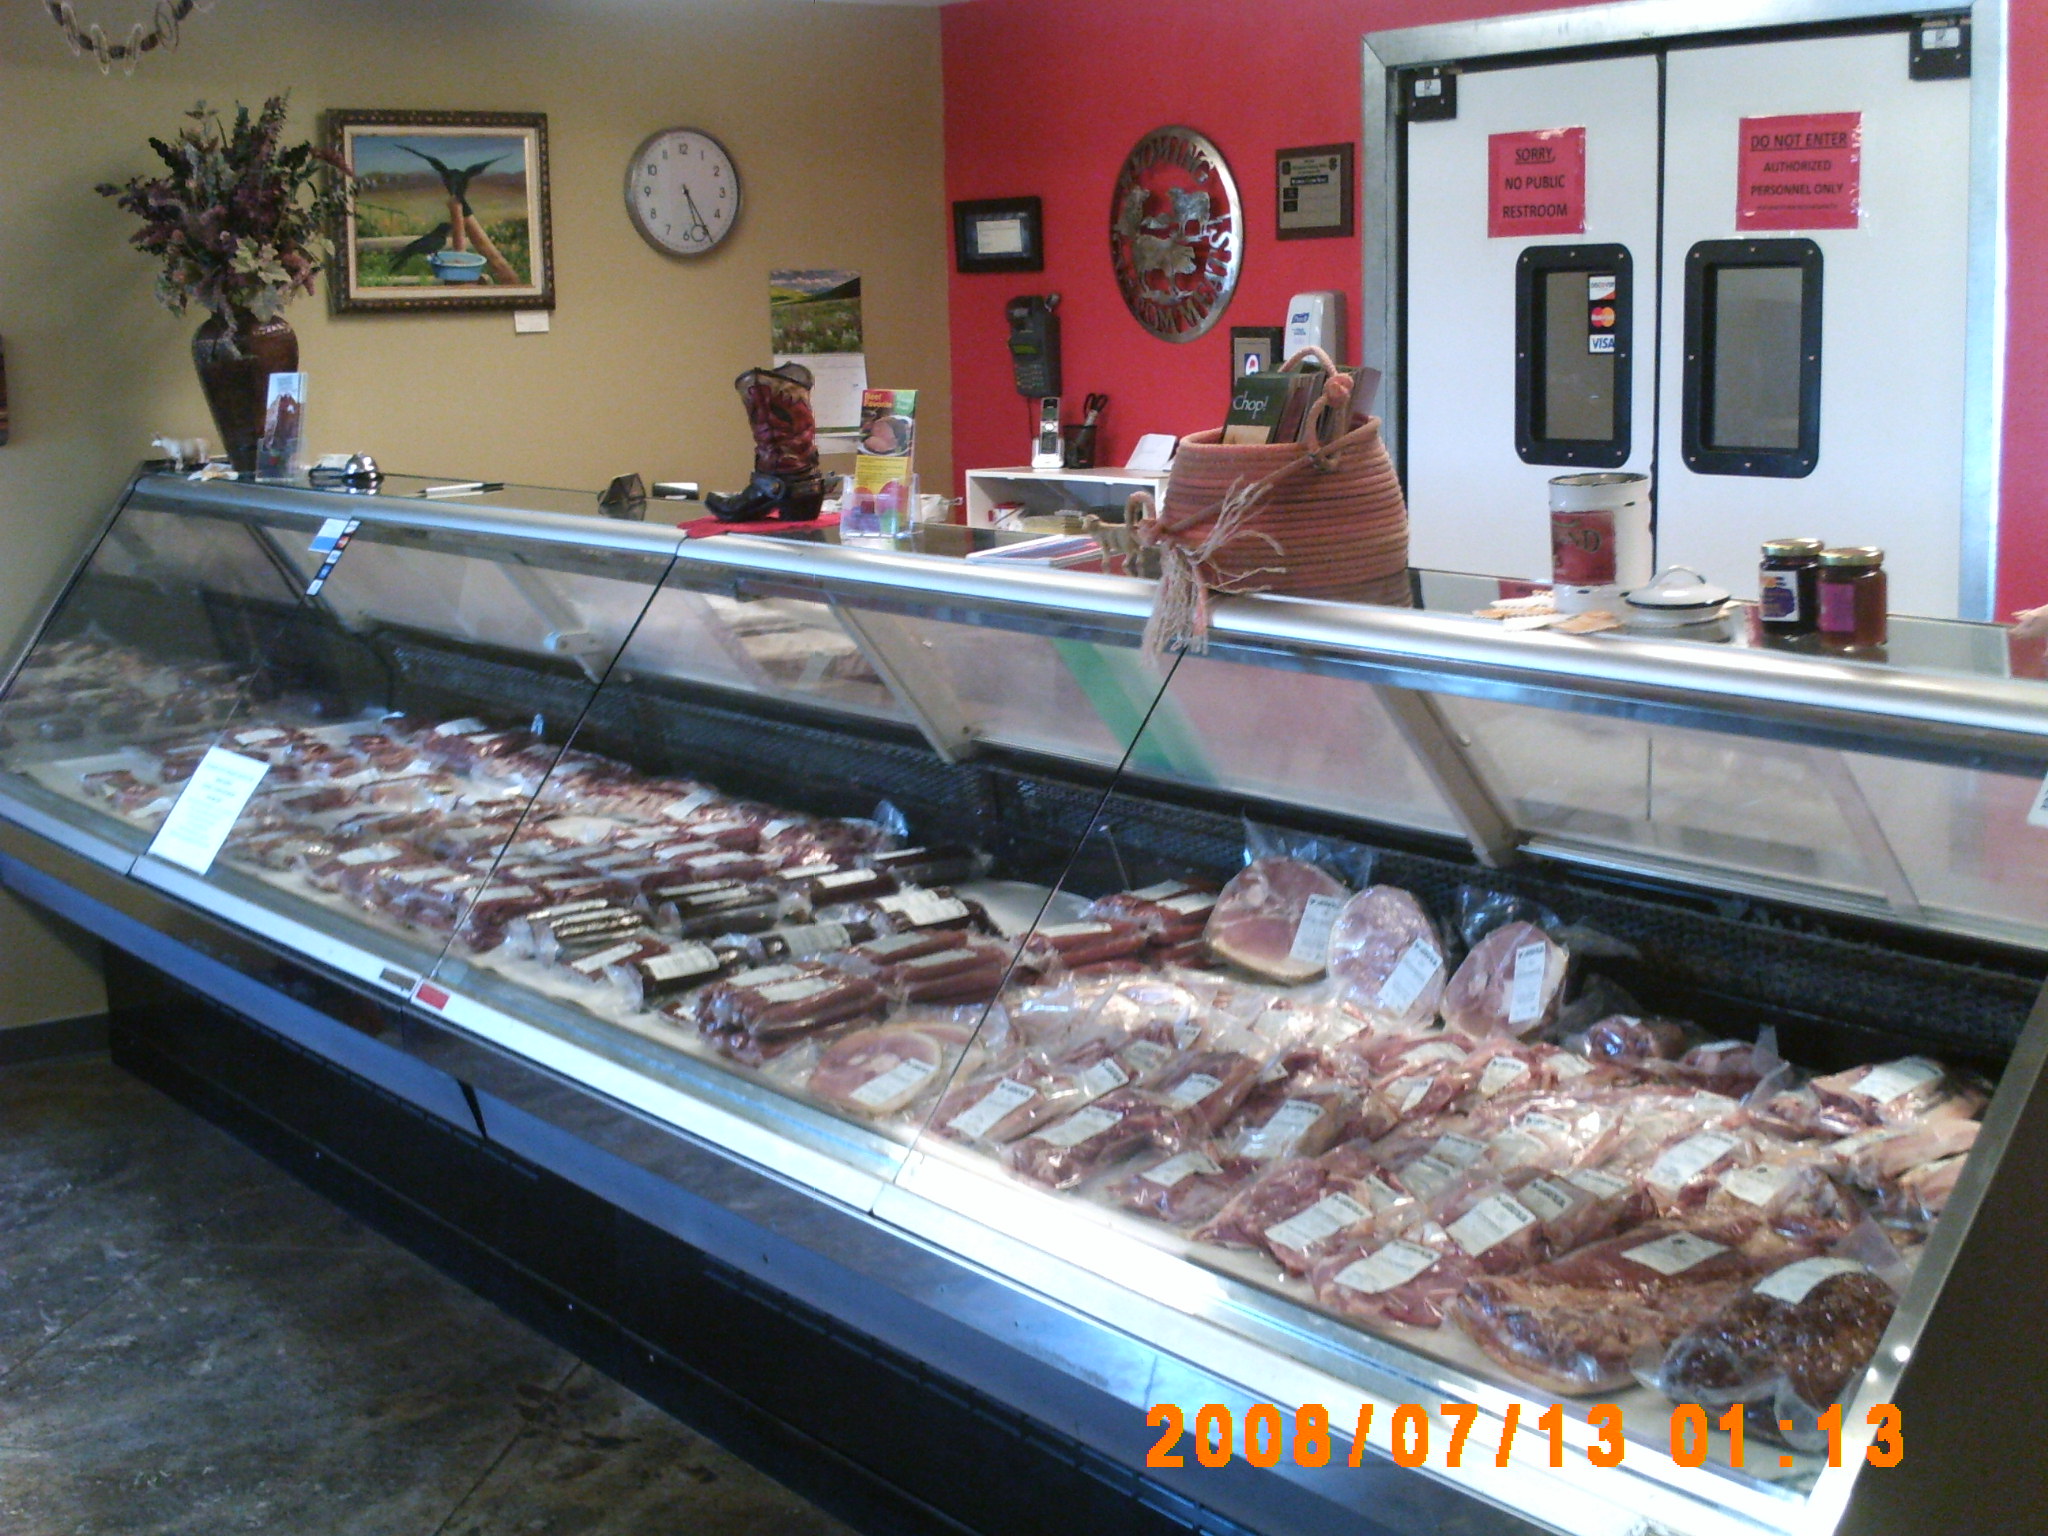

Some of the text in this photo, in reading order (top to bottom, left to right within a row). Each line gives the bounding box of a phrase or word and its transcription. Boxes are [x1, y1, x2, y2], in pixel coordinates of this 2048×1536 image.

[1751, 131, 1847, 149] DO NOT ENTER
[679, 143, 688, 155] 12
[647, 164, 657, 176] 10
[713, 165, 720, 177] 2
[1763, 160, 1831, 173] AUTHORIZED
[1505, 174, 1566, 190] NO PUBLIC
[644, 186, 651, 197] 9
[720, 187, 726, 198] 3
[1750, 183, 1844, 196] PERSONNEL ONLY
[650, 208, 656, 219] 8
[714, 209, 721, 219] 4
[1502, 203, 1568, 218] RESTROOM
[665, 224, 671, 235] 7
[683, 230, 690, 241] 6
[1592, 338, 1615, 350] VISA
[1233, 389, 1269, 420] Chop!
